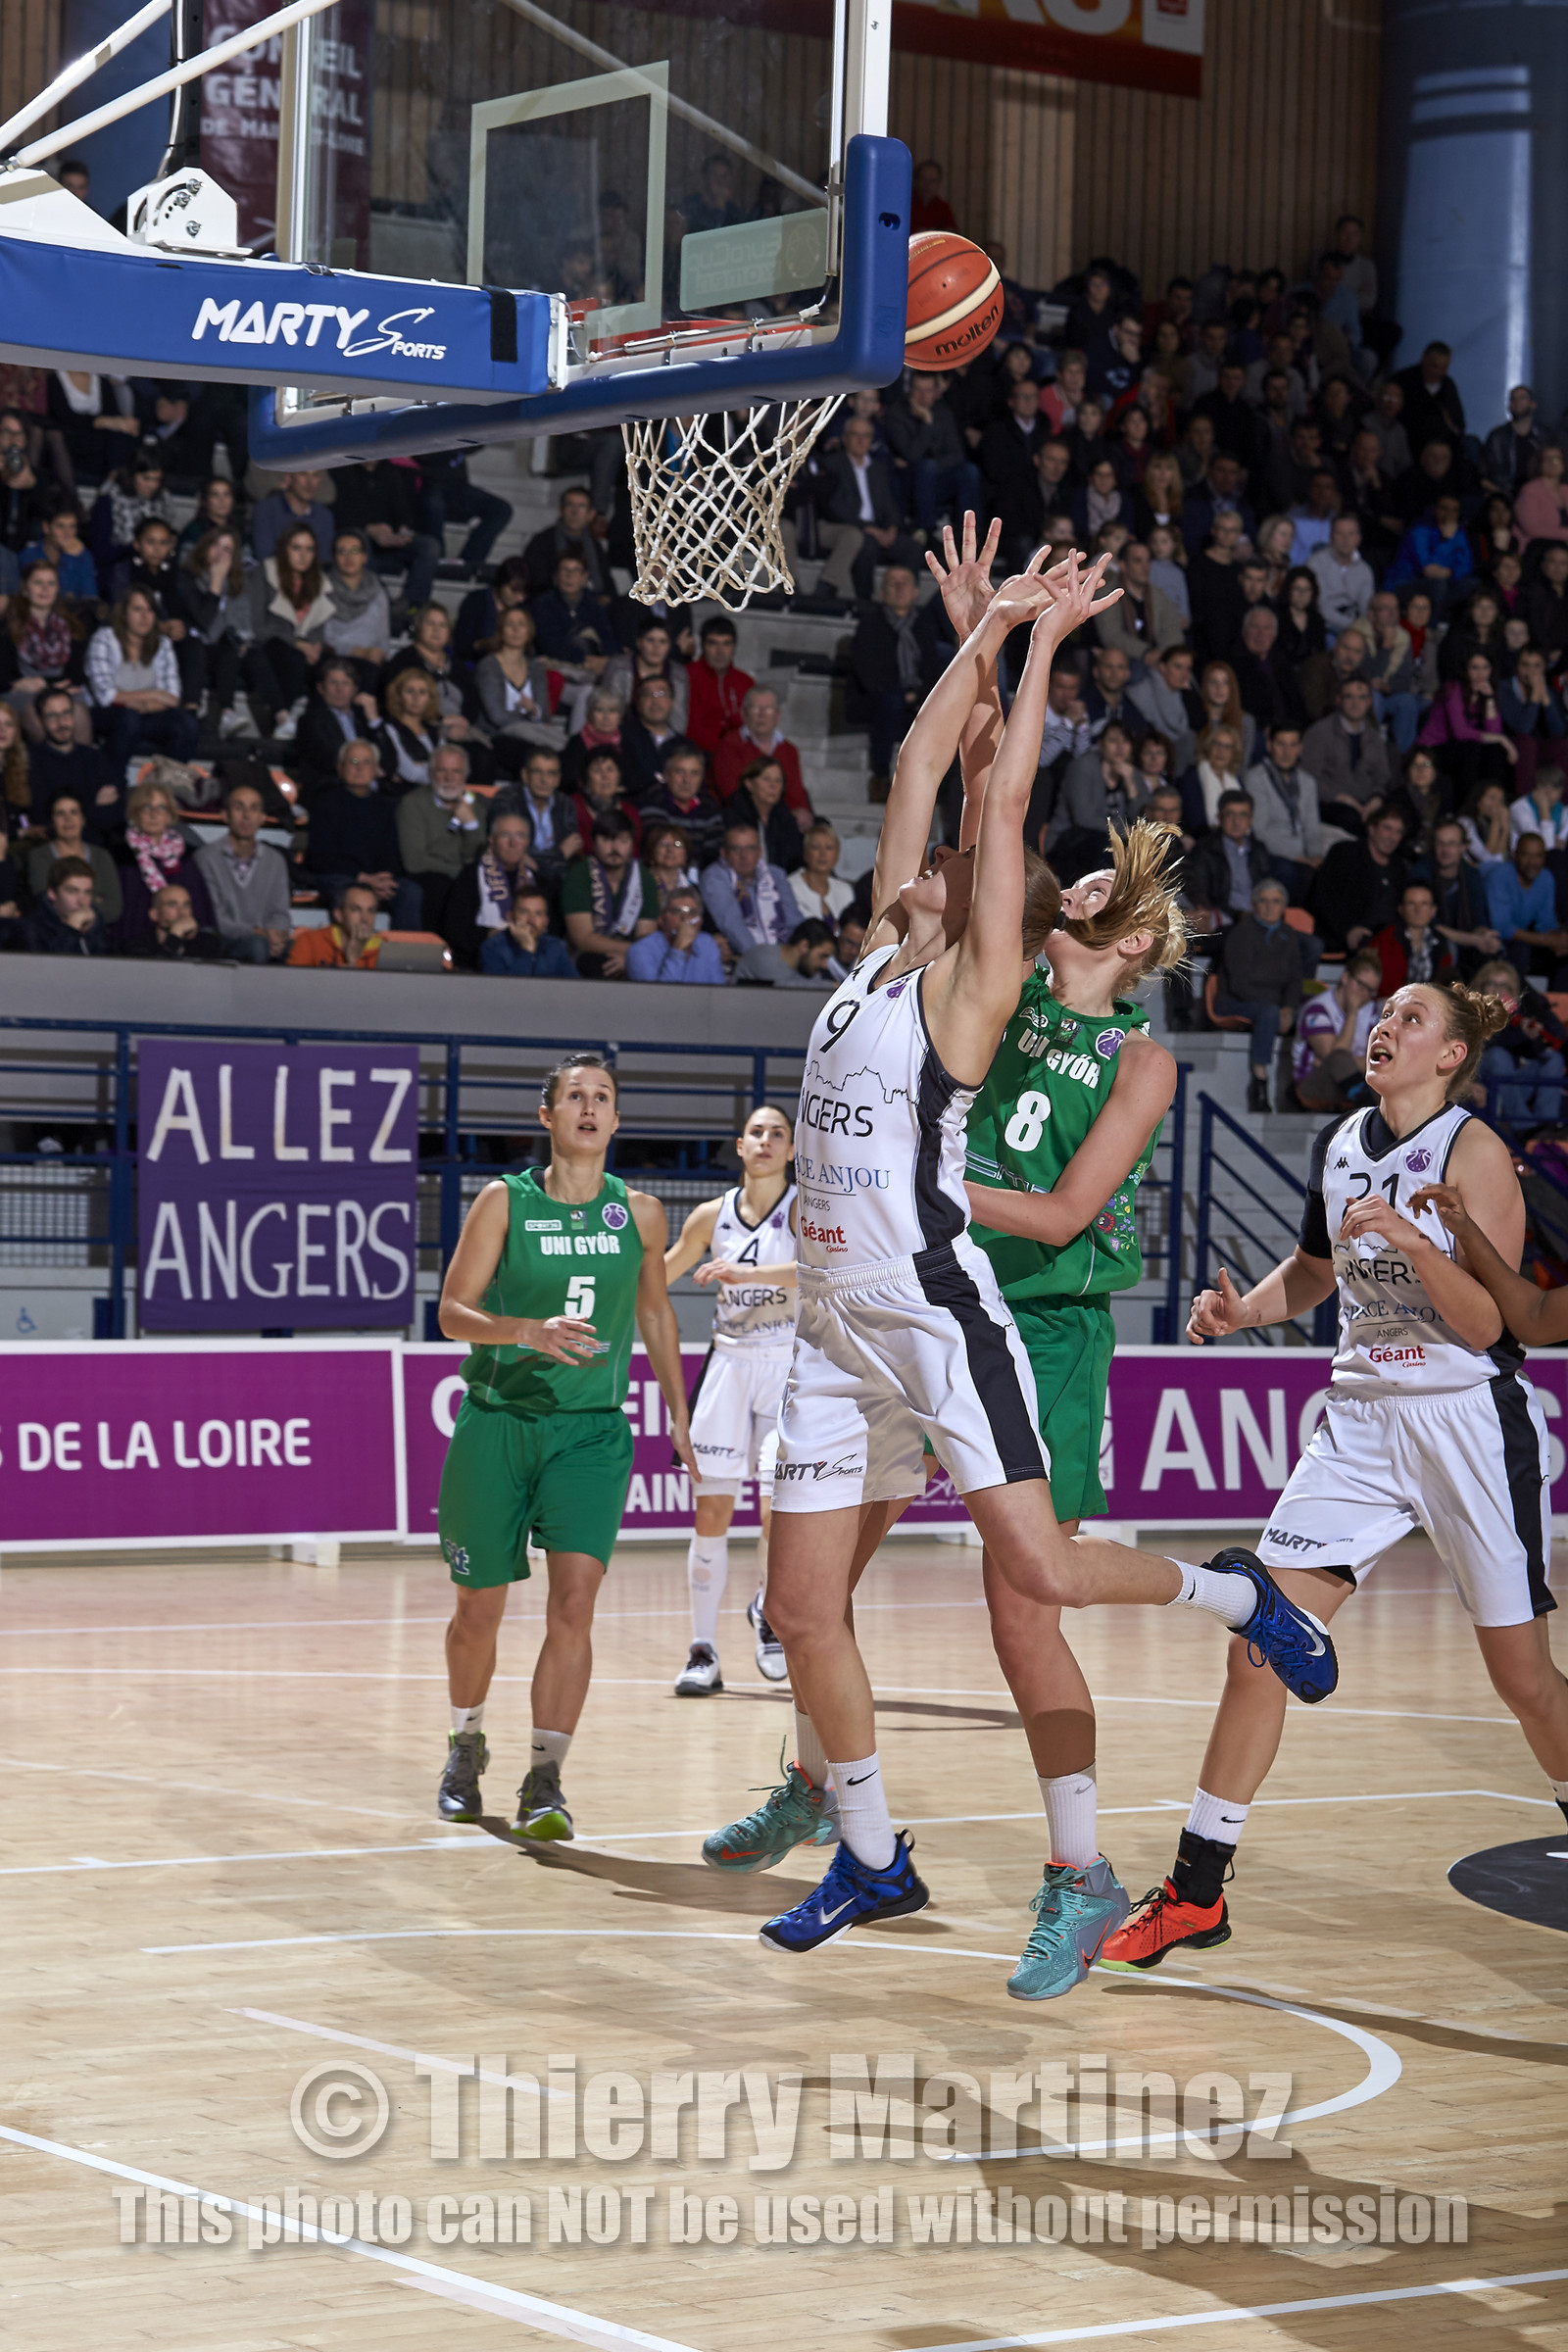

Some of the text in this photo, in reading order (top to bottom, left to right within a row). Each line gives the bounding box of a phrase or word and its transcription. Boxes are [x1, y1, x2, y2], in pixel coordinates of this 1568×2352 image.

[191, 297, 369, 350] MARTY
[935, 305, 999, 357] molten
[819, 999, 860, 1054] 9
[146, 1064, 413, 1164] ALLEZ
[1004, 1090, 1052, 1152] 8
[818, 1162, 891, 1193] ANJOU
[804, 1195, 831, 1211] ANGERS
[540, 1235, 572, 1255] UNI
[801, 1215, 846, 1244] Géant
[144, 1200, 410, 1300] ANGERS
[737, 1238, 760, 1267] 4
[564, 1276, 596, 1320] 5
[1376, 1327, 1409, 1339] ANGERS
[1369, 1345, 1426, 1363] Géant
[18, 1422, 82, 1471] DE
[98, 1421, 160, 1470] LA
[173, 1418, 312, 1469] LOIRE
[774, 1460, 828, 1481] ARTY
